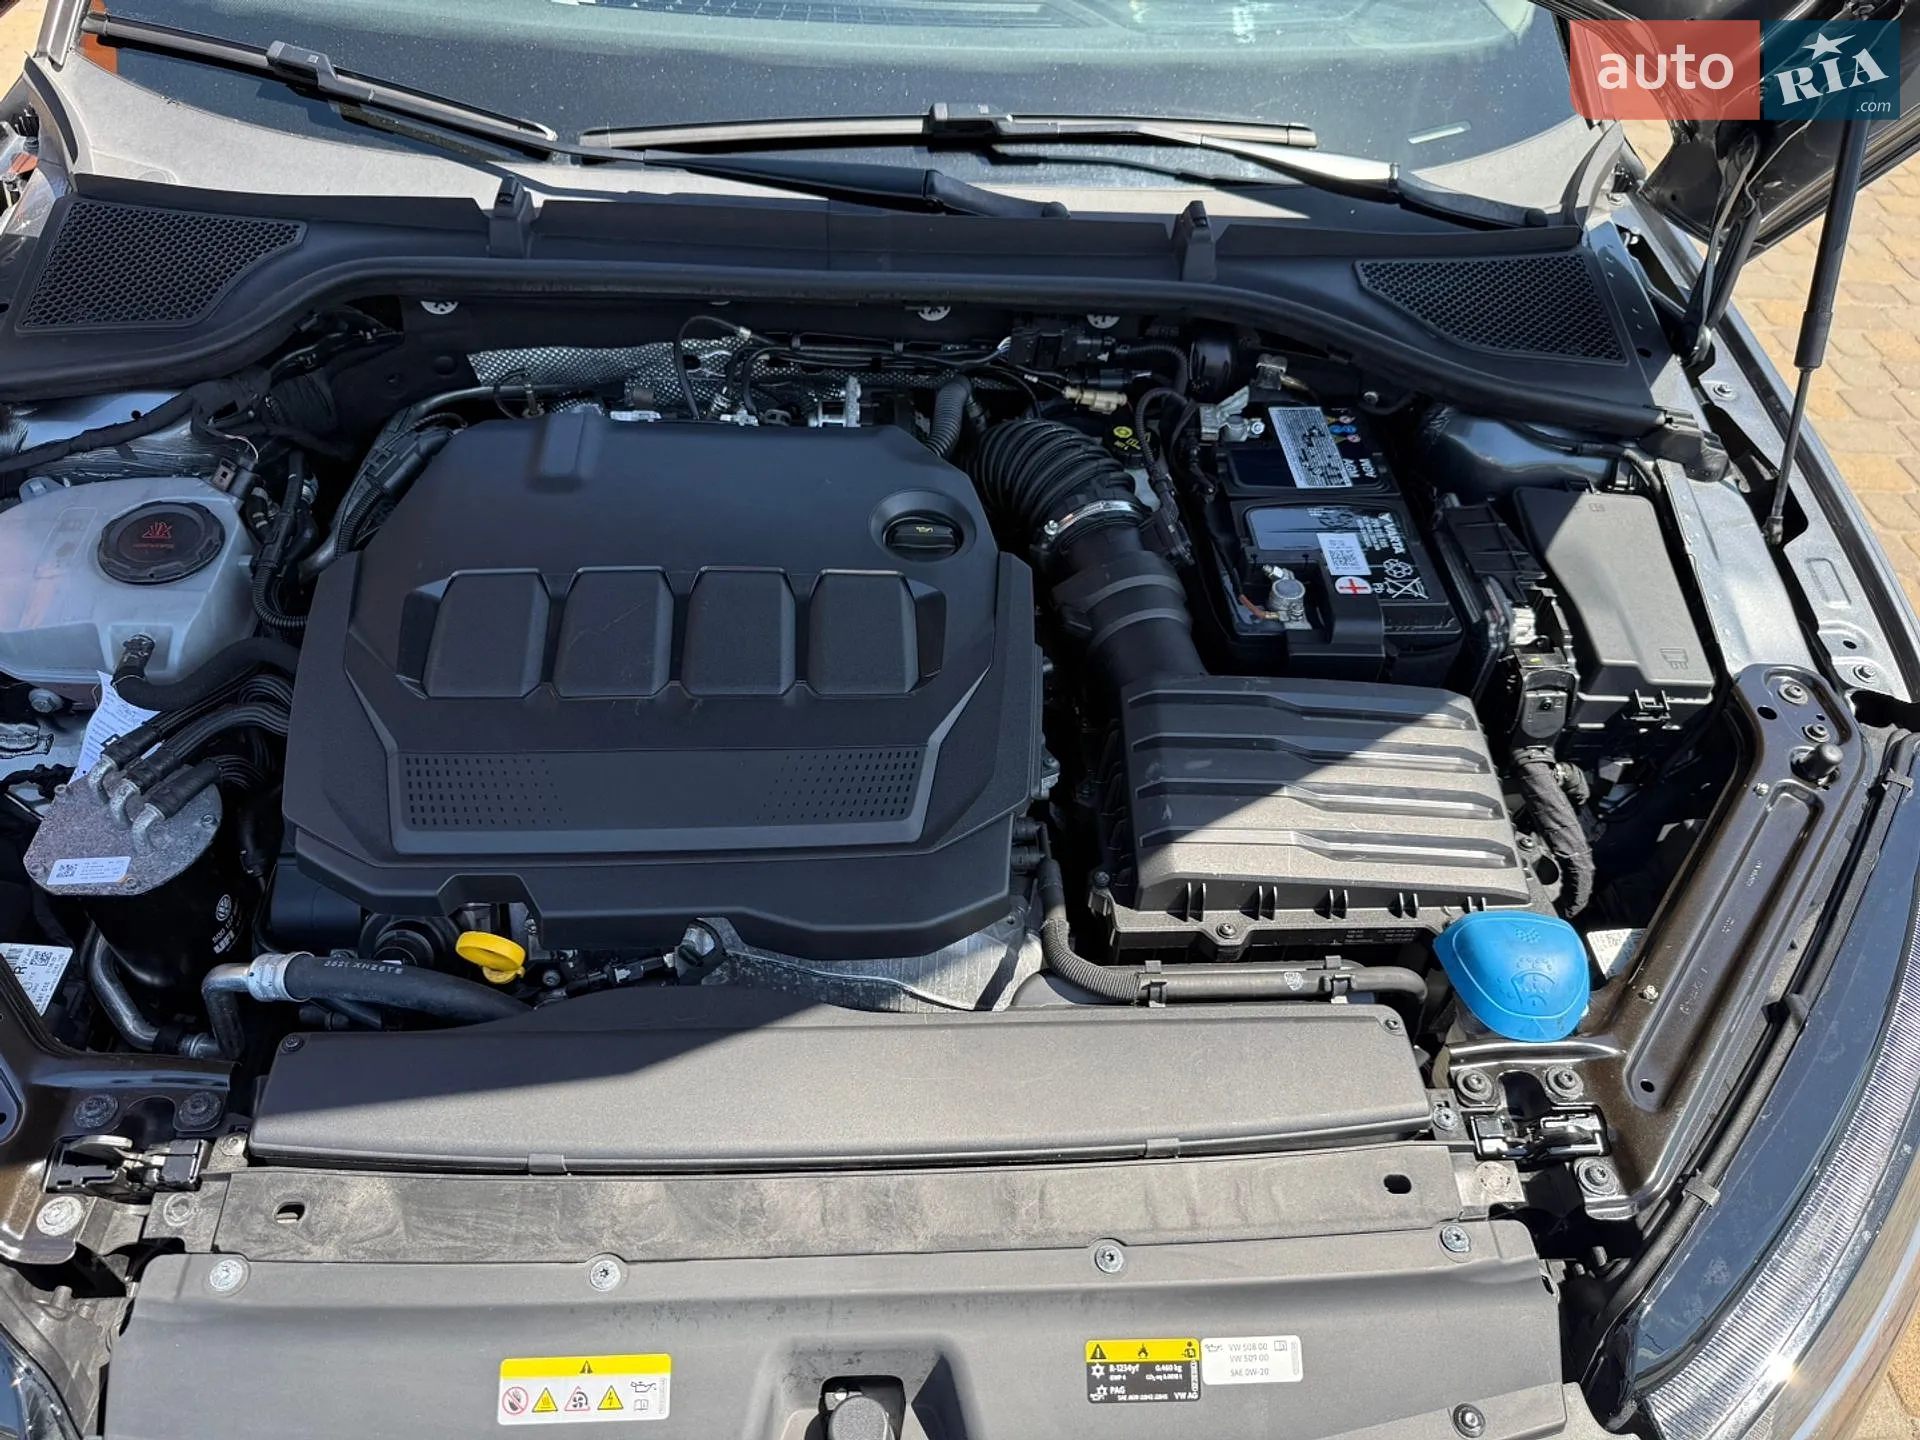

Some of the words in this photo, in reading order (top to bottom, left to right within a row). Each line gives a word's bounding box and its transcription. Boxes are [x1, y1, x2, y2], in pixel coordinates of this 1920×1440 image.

[1383, 523, 1405, 554] VARTA
[1228, 1343, 1241, 1351] VW
[1258, 1342, 1268, 1351] 00
[1229, 1354, 1242, 1363] VW
[1259, 1353, 1269, 1362] 00
[1244, 1367, 1269, 1376] 0W-20
[1109, 1386, 1126, 1395] PAG
[1174, 1391, 1187, 1400] VW
